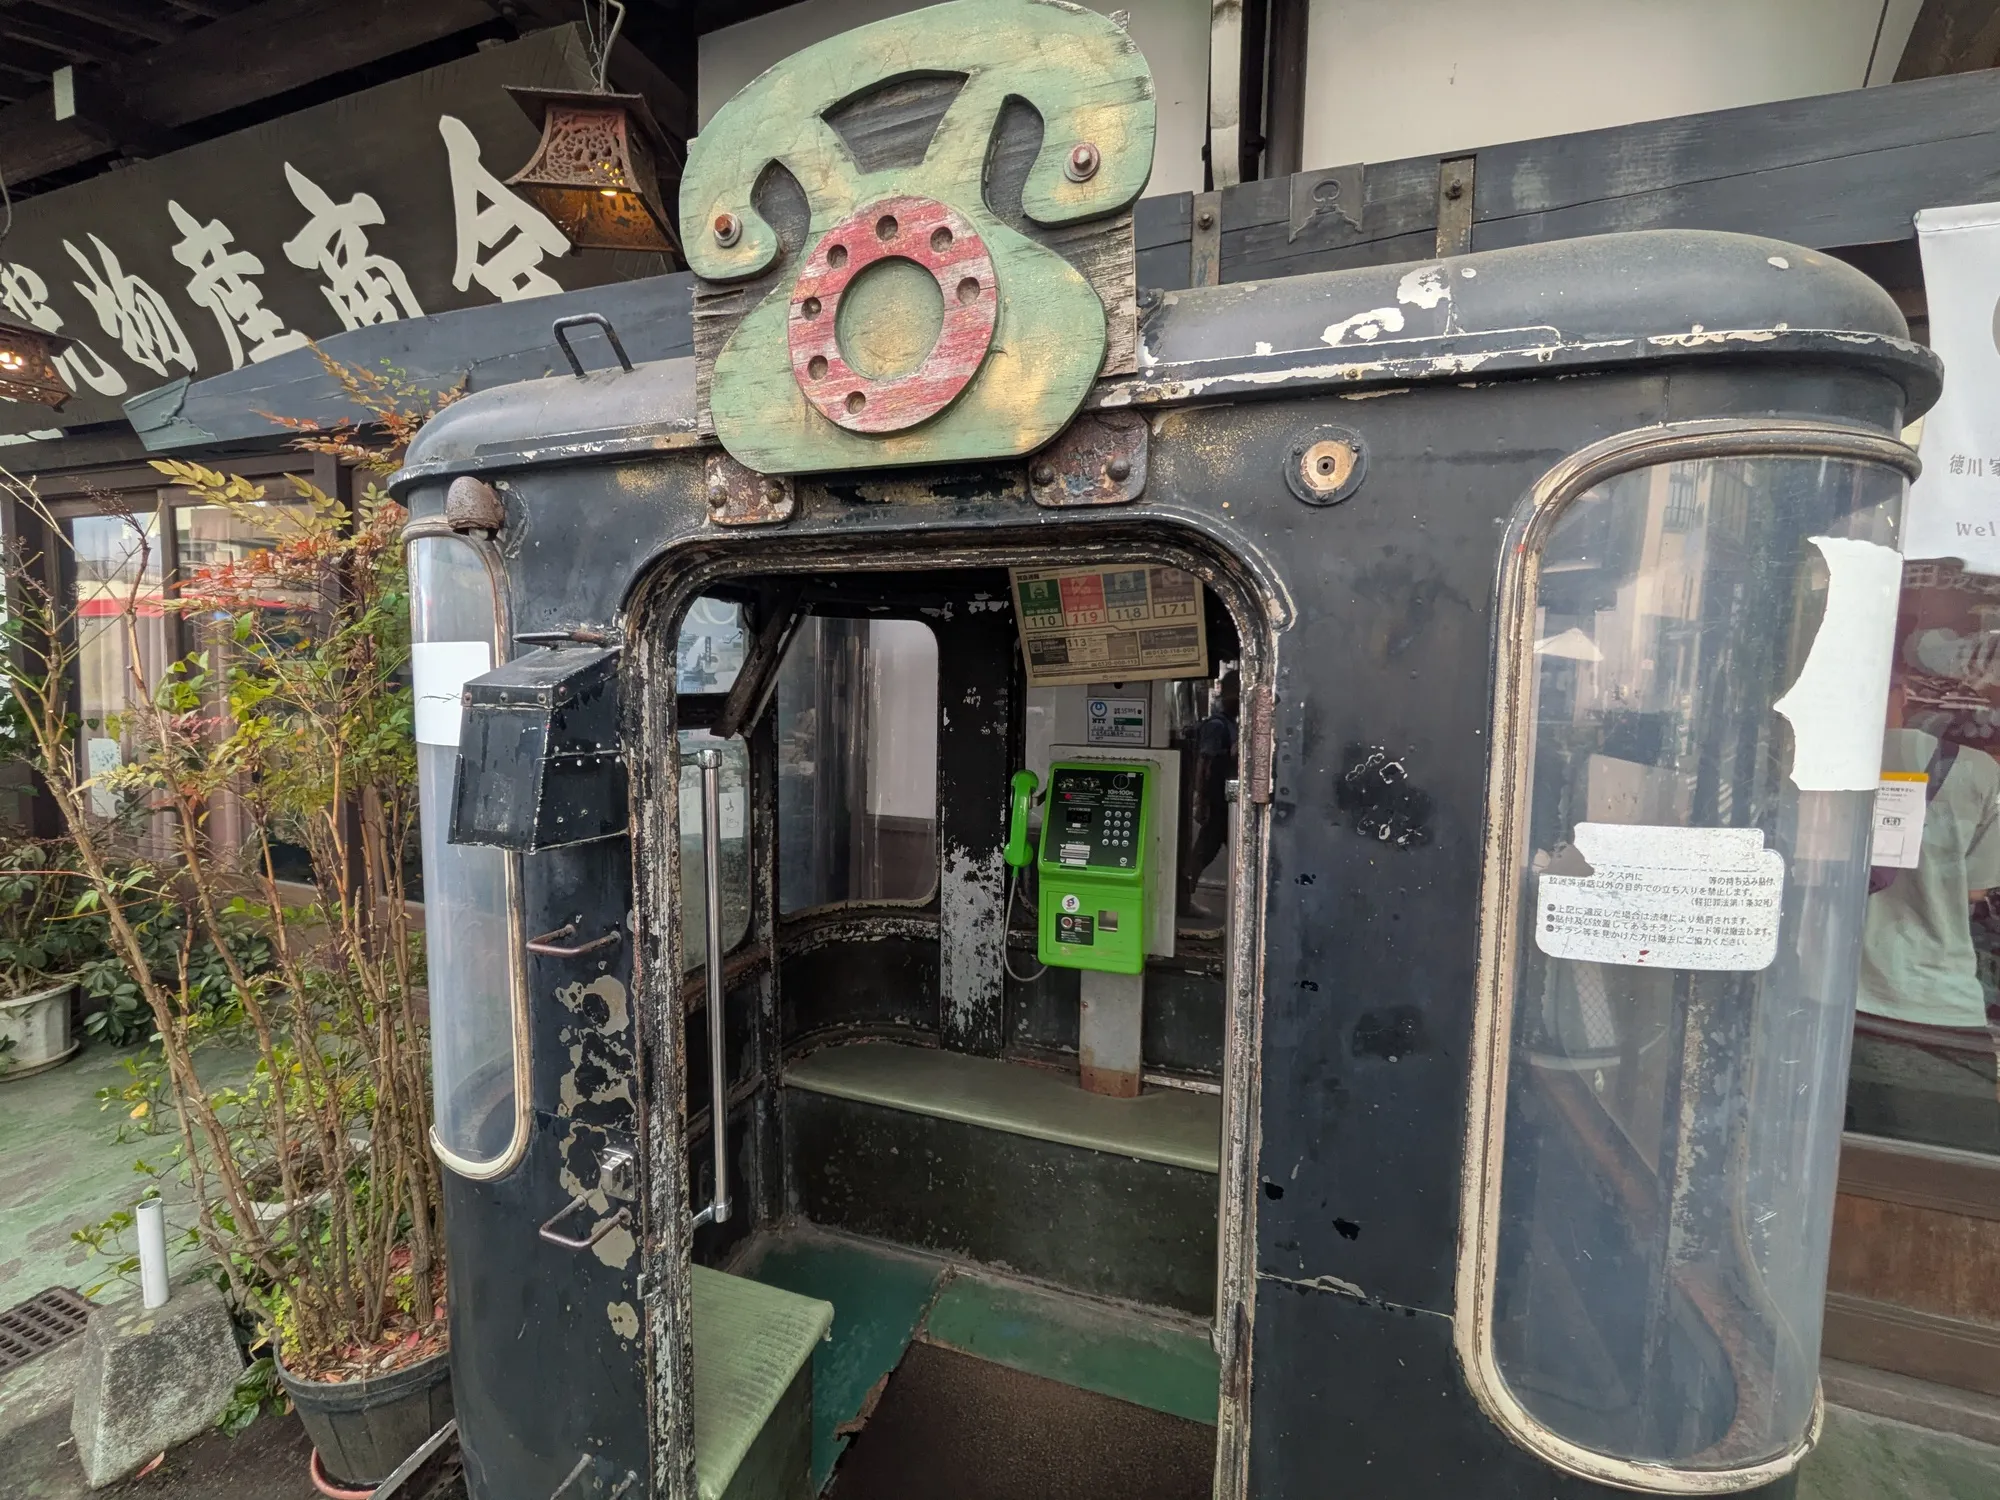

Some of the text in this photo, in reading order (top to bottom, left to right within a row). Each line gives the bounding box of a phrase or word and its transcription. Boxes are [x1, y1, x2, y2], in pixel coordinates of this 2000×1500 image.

[1115, 607, 1142, 620] 118
[1160, 603, 1188, 616] 171
[1031, 615, 1056, 627] 110
[1072, 611, 1098, 624] 119
[1066, 639, 1088, 648] 113
